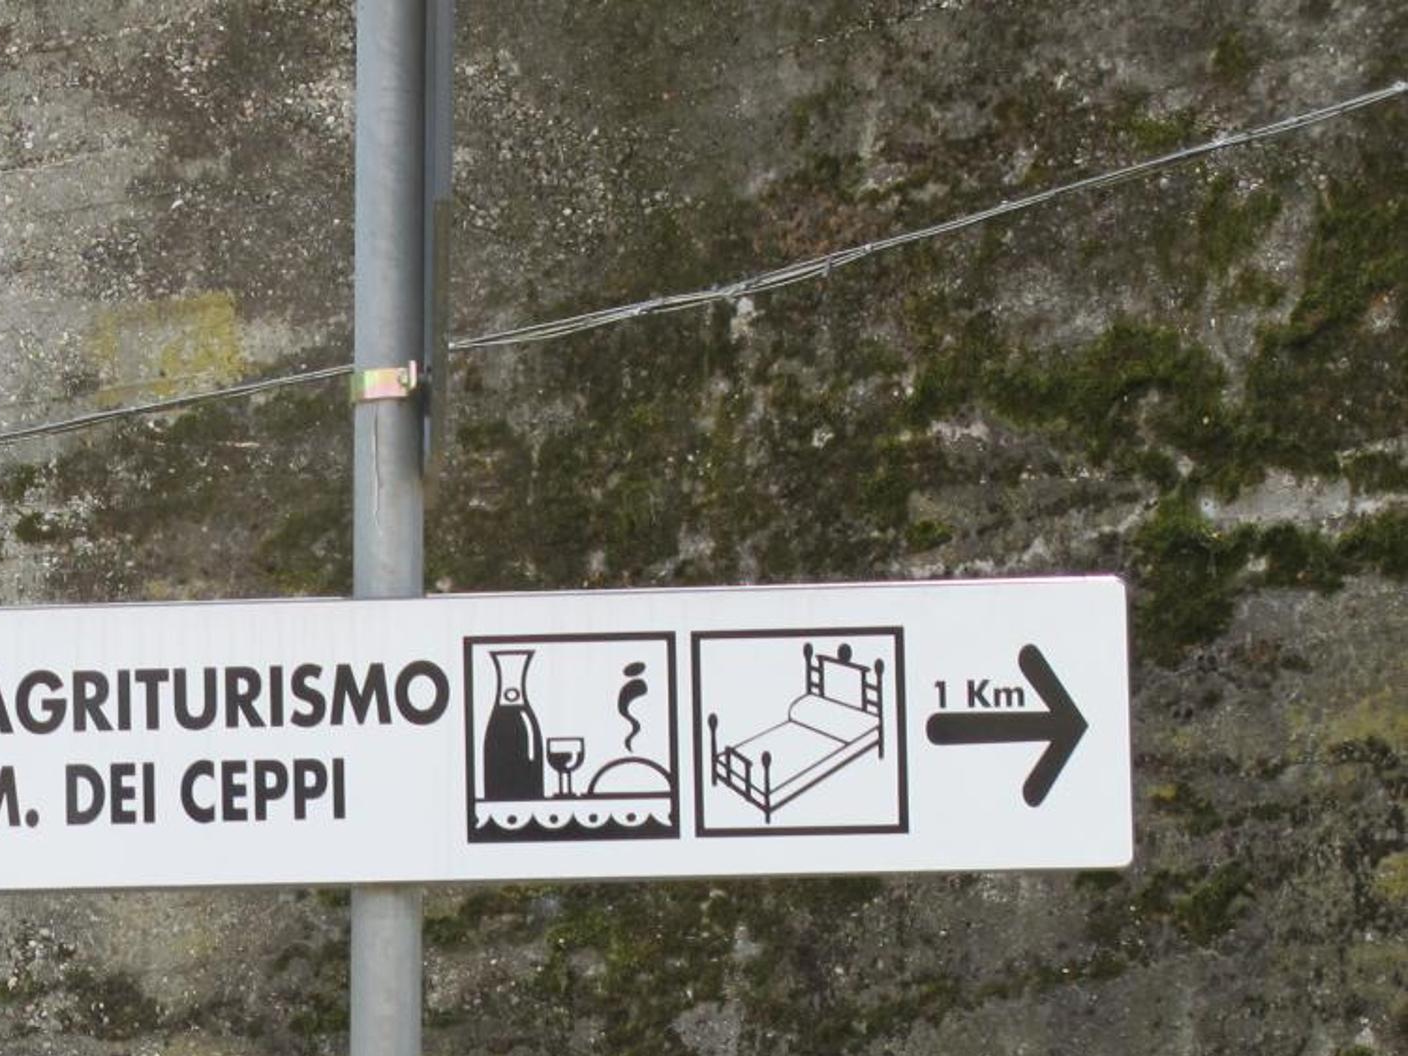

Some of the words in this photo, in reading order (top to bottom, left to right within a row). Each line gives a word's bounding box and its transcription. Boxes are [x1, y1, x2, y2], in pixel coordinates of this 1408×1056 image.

[934, 681, 947, 708] 1
[967, 679, 1026, 708] Km
[65, 763, 156, 825] DEI
[180, 757, 348, 821] CEPPI
